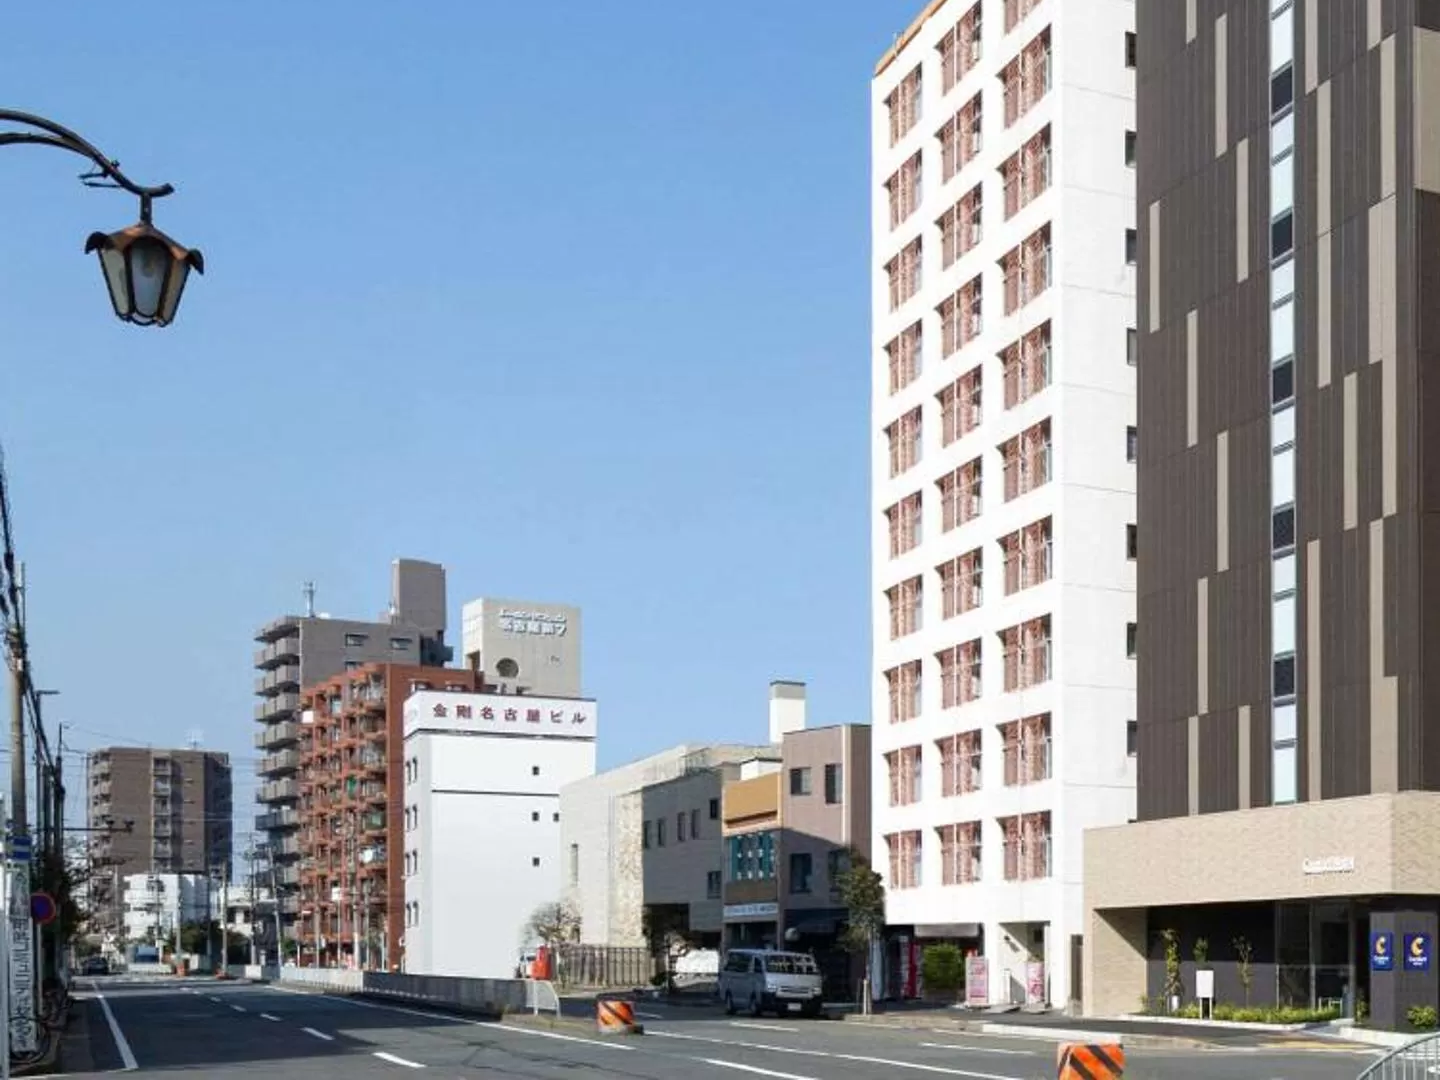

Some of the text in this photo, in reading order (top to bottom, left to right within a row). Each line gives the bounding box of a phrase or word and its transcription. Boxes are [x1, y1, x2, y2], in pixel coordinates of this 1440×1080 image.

[432, 702, 588, 725] 金剛名古屋ビル
